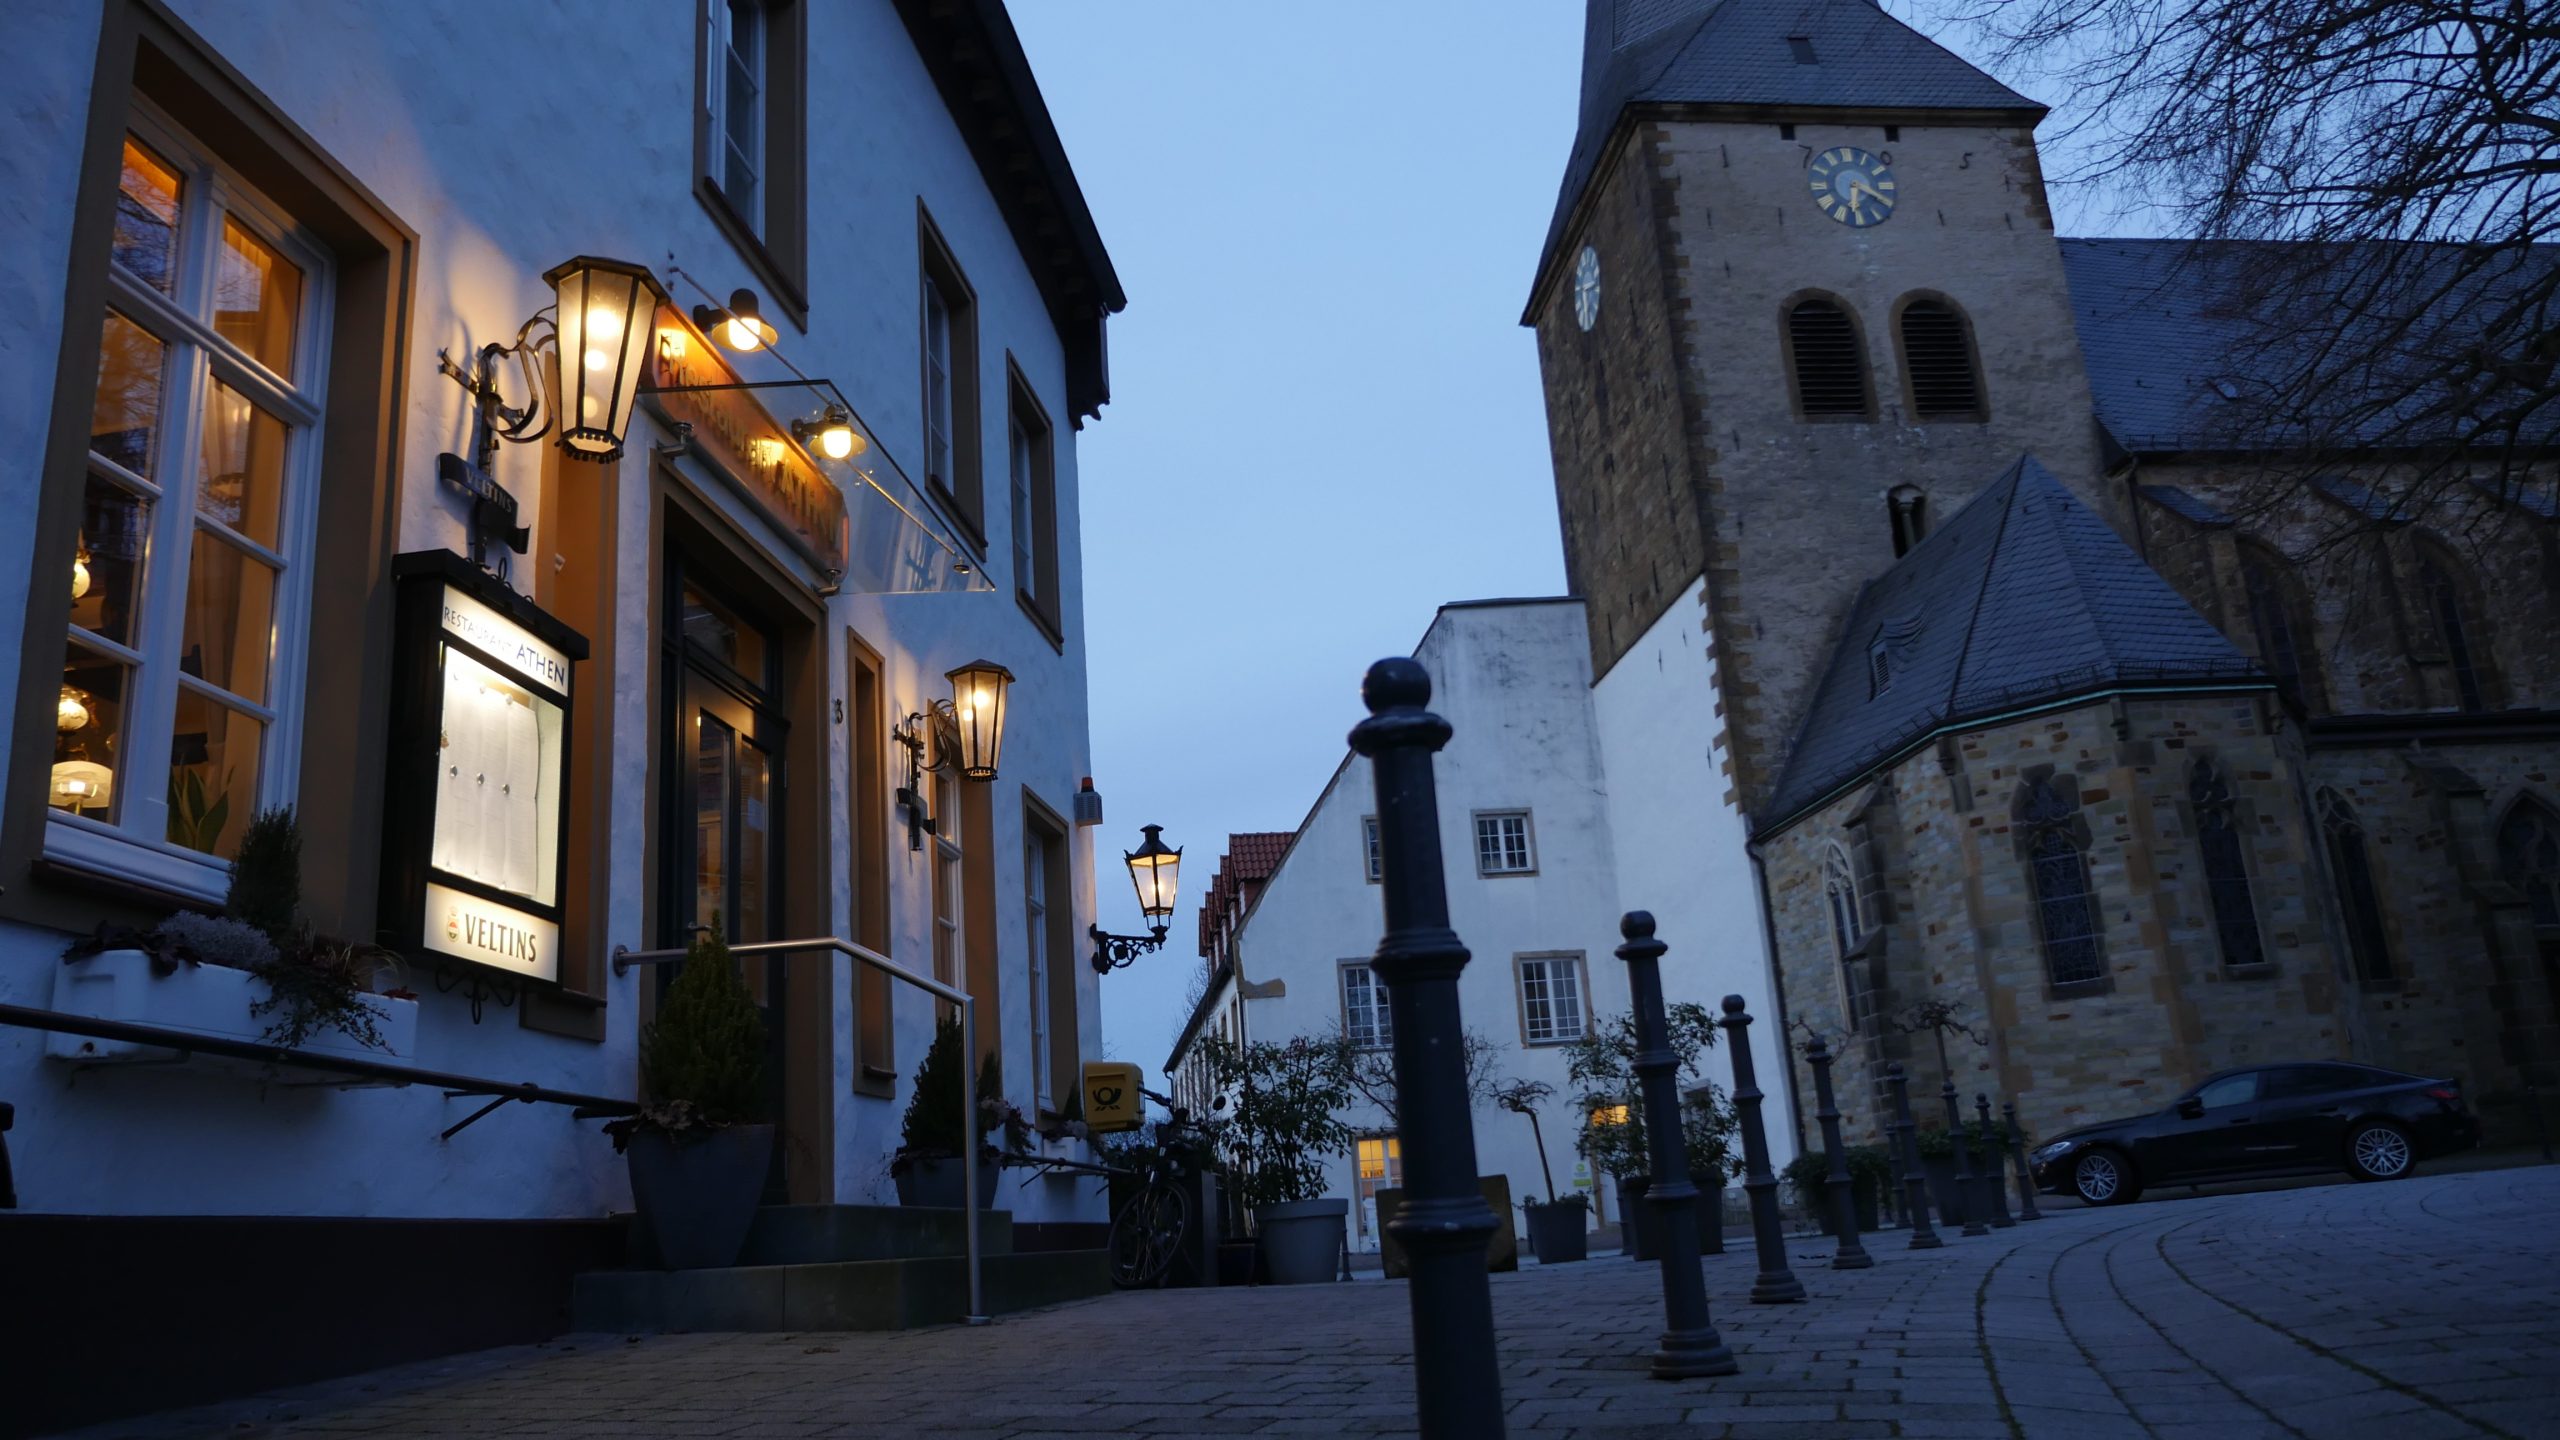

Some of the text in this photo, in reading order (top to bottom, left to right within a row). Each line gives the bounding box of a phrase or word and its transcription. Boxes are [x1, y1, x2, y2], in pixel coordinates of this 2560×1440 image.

[466, 467, 511, 512] VELTINS
[517, 643, 565, 686] ATHEN
[465, 913, 536, 962] VELTINS
